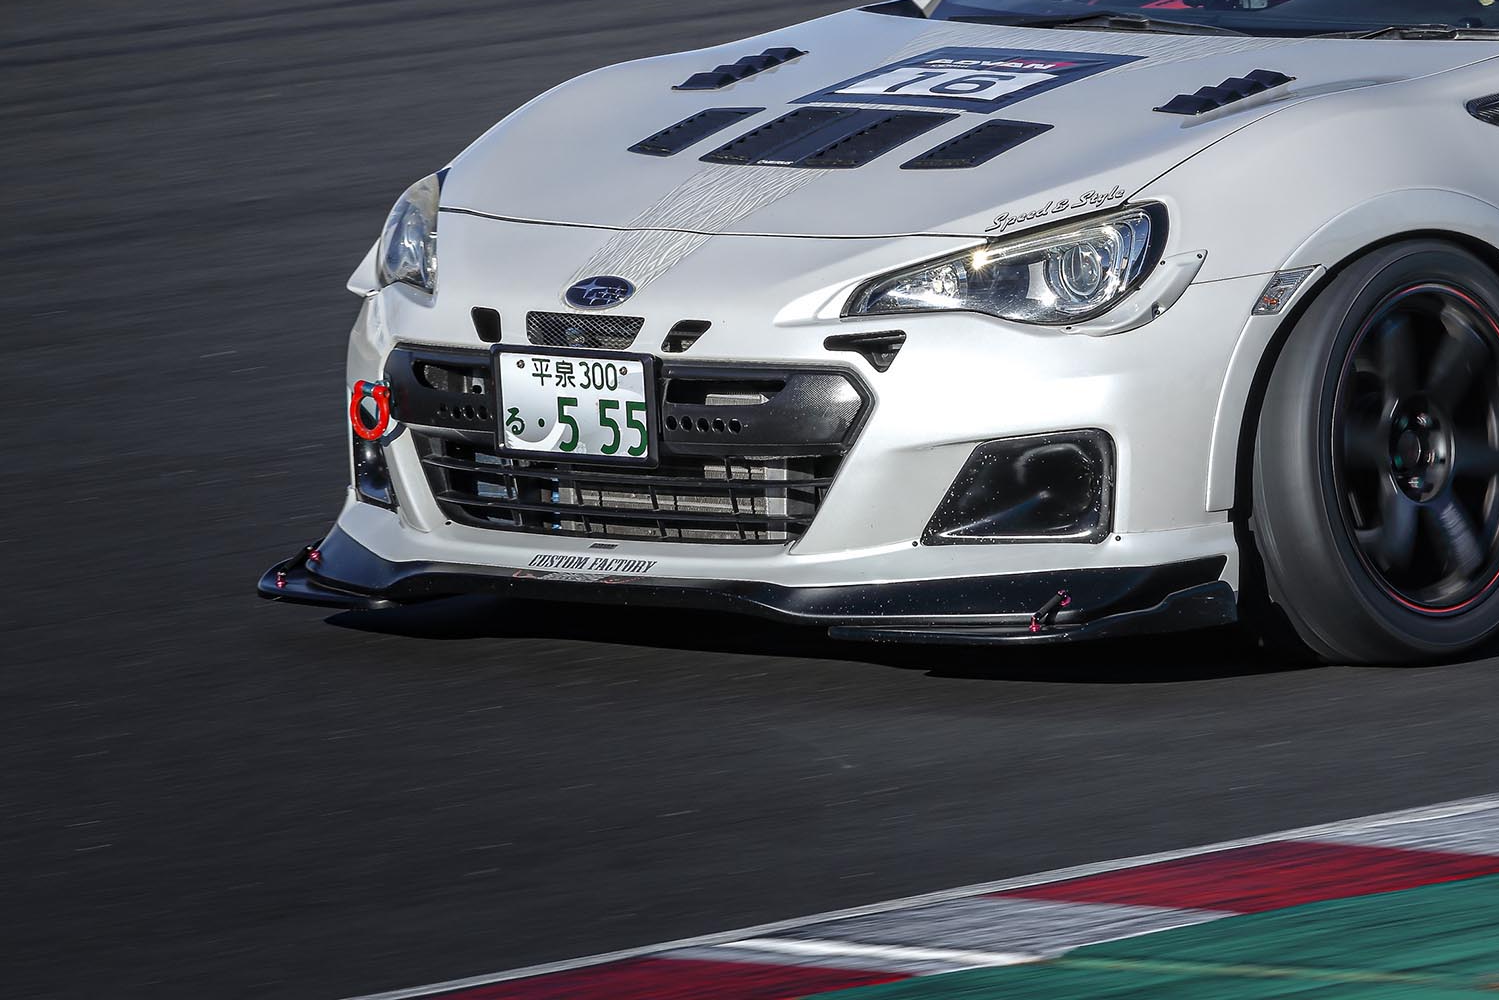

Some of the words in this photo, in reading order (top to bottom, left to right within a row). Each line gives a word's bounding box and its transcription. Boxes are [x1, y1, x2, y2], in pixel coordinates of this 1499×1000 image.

[926, 59, 1057, 70] ADVAN
[885, 71, 1016, 96] 16
[985, 201, 1051, 232] Speed
[1051, 200, 1070, 213] &
[1071, 185, 1126, 207] Style
[529, 554, 590, 569] CUSTOM
[588, 558, 657, 573] FACTORY
